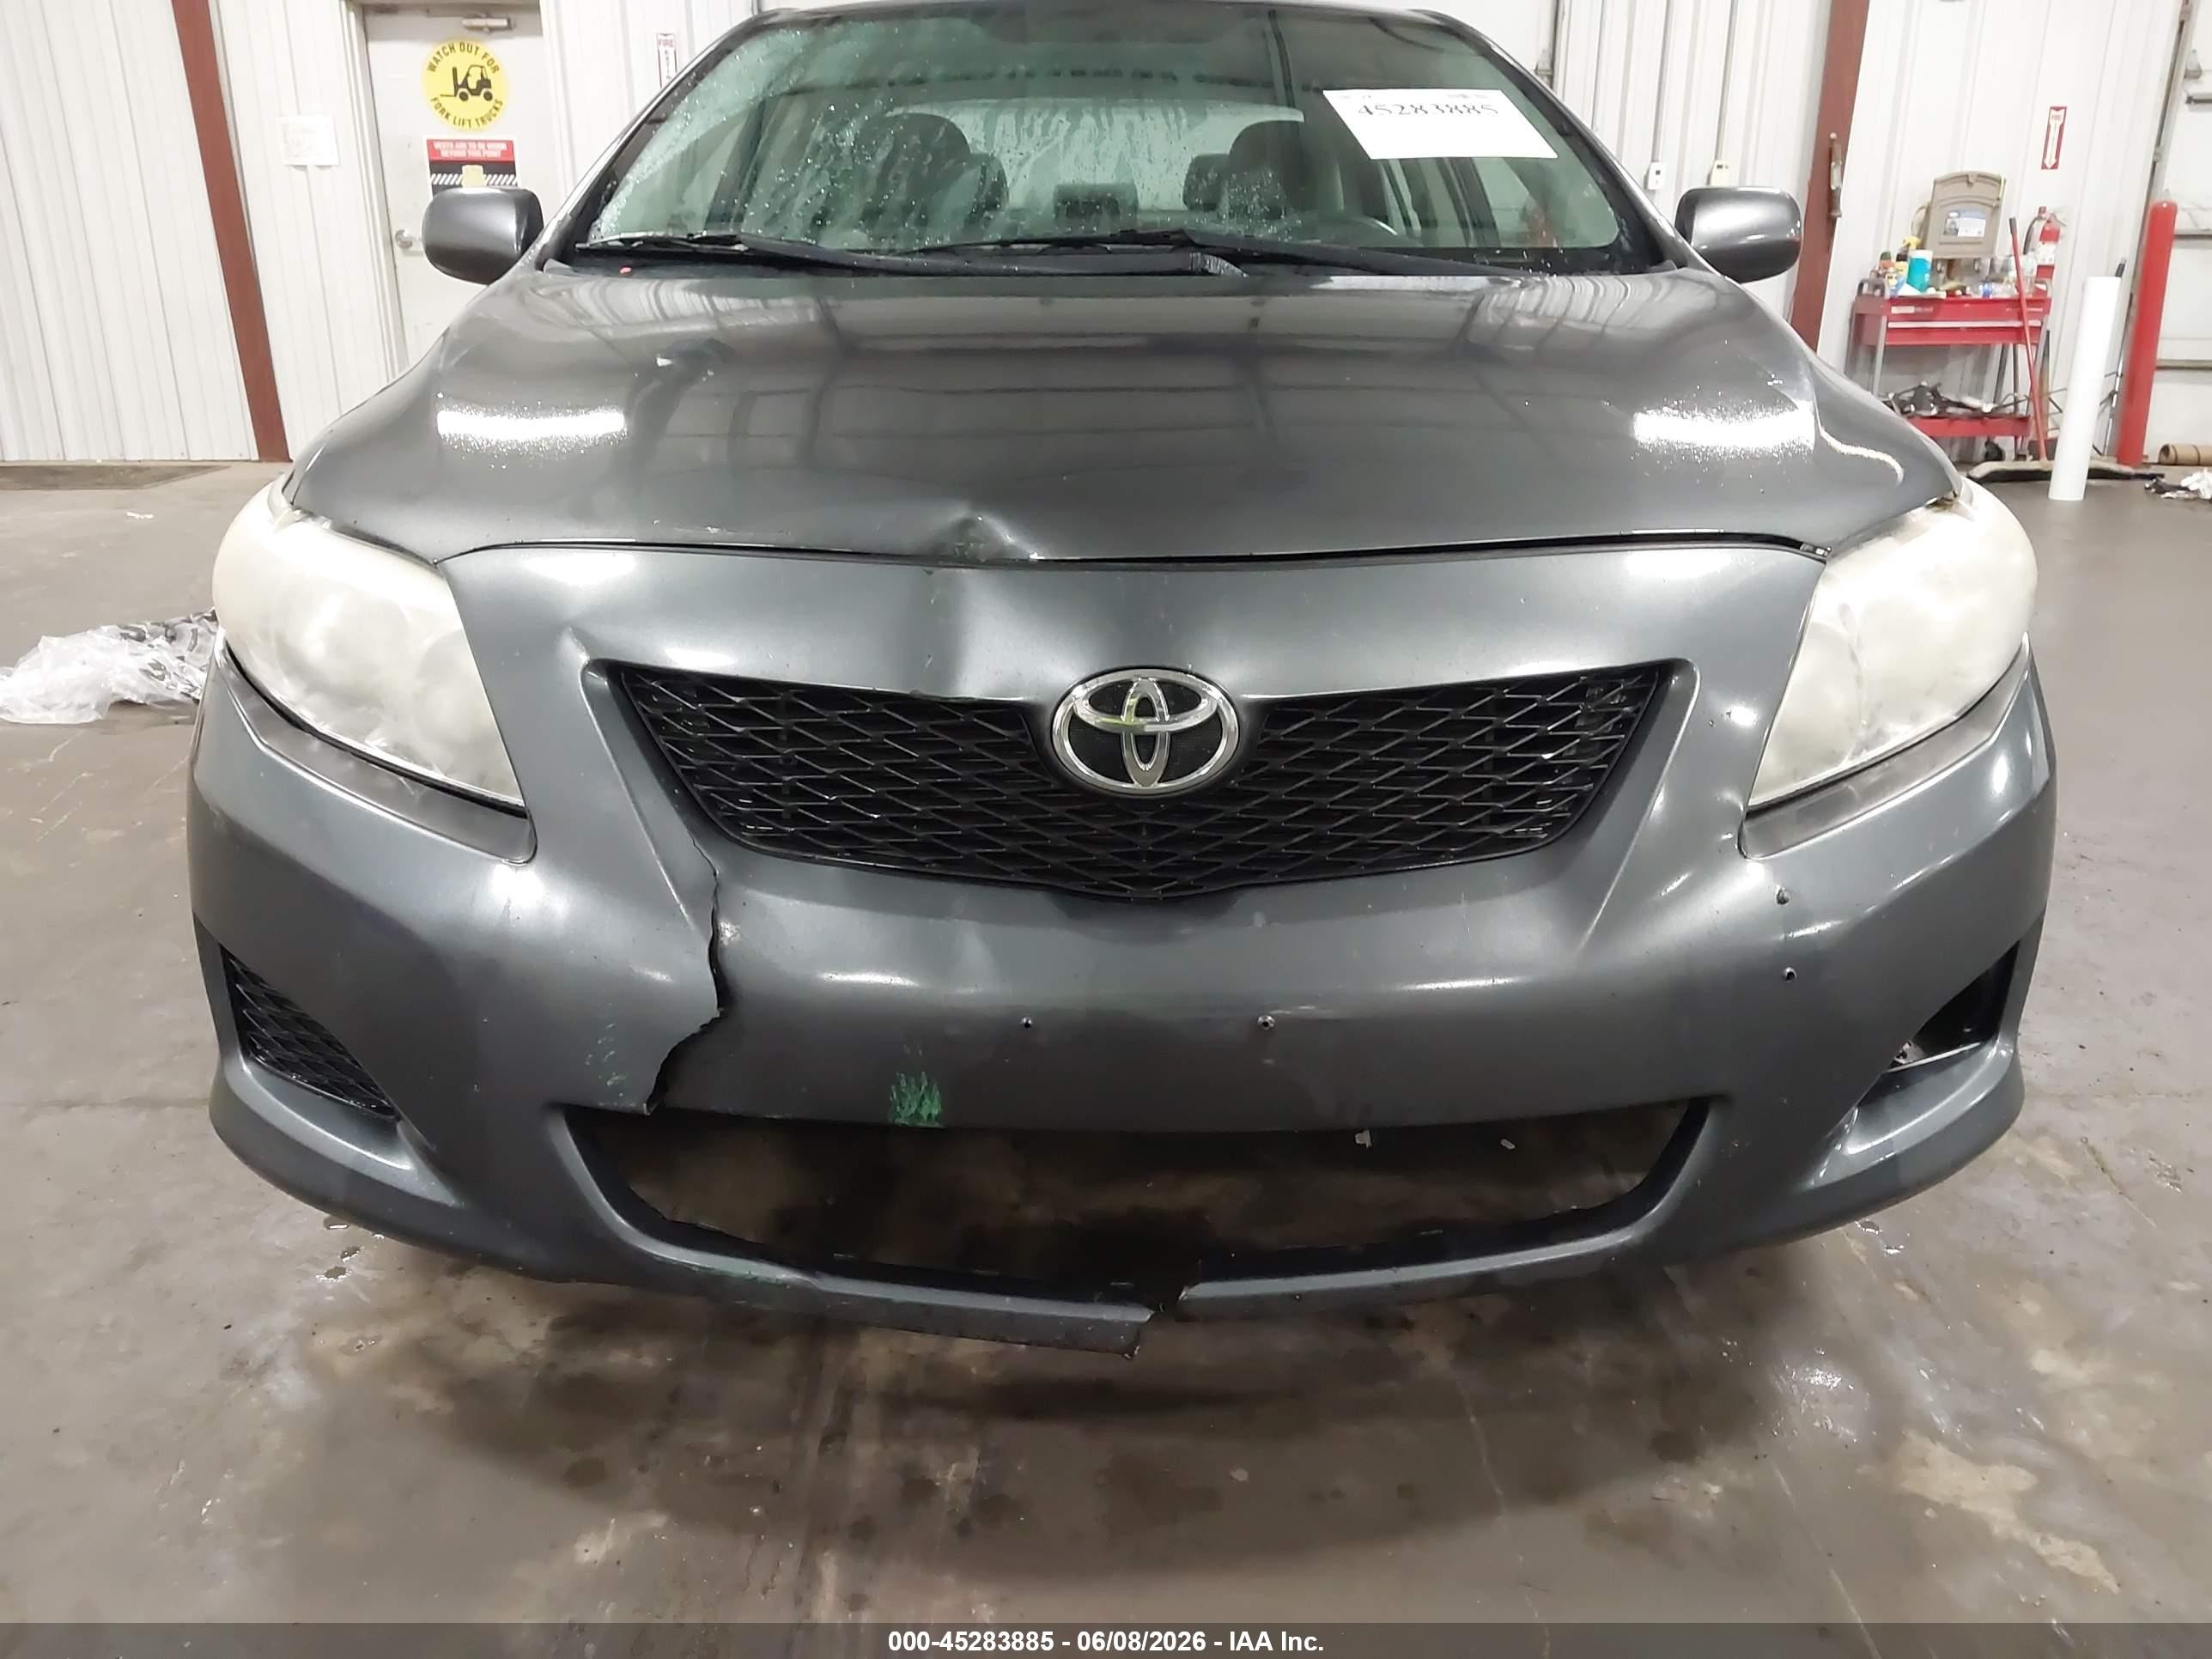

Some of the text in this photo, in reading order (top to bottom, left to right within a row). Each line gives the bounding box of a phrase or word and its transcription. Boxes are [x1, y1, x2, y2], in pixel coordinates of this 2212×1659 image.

[427, 42, 500, 74] WATCH OUT FOR
[431, 97, 503, 129] FORK LIFT TRUCKS
